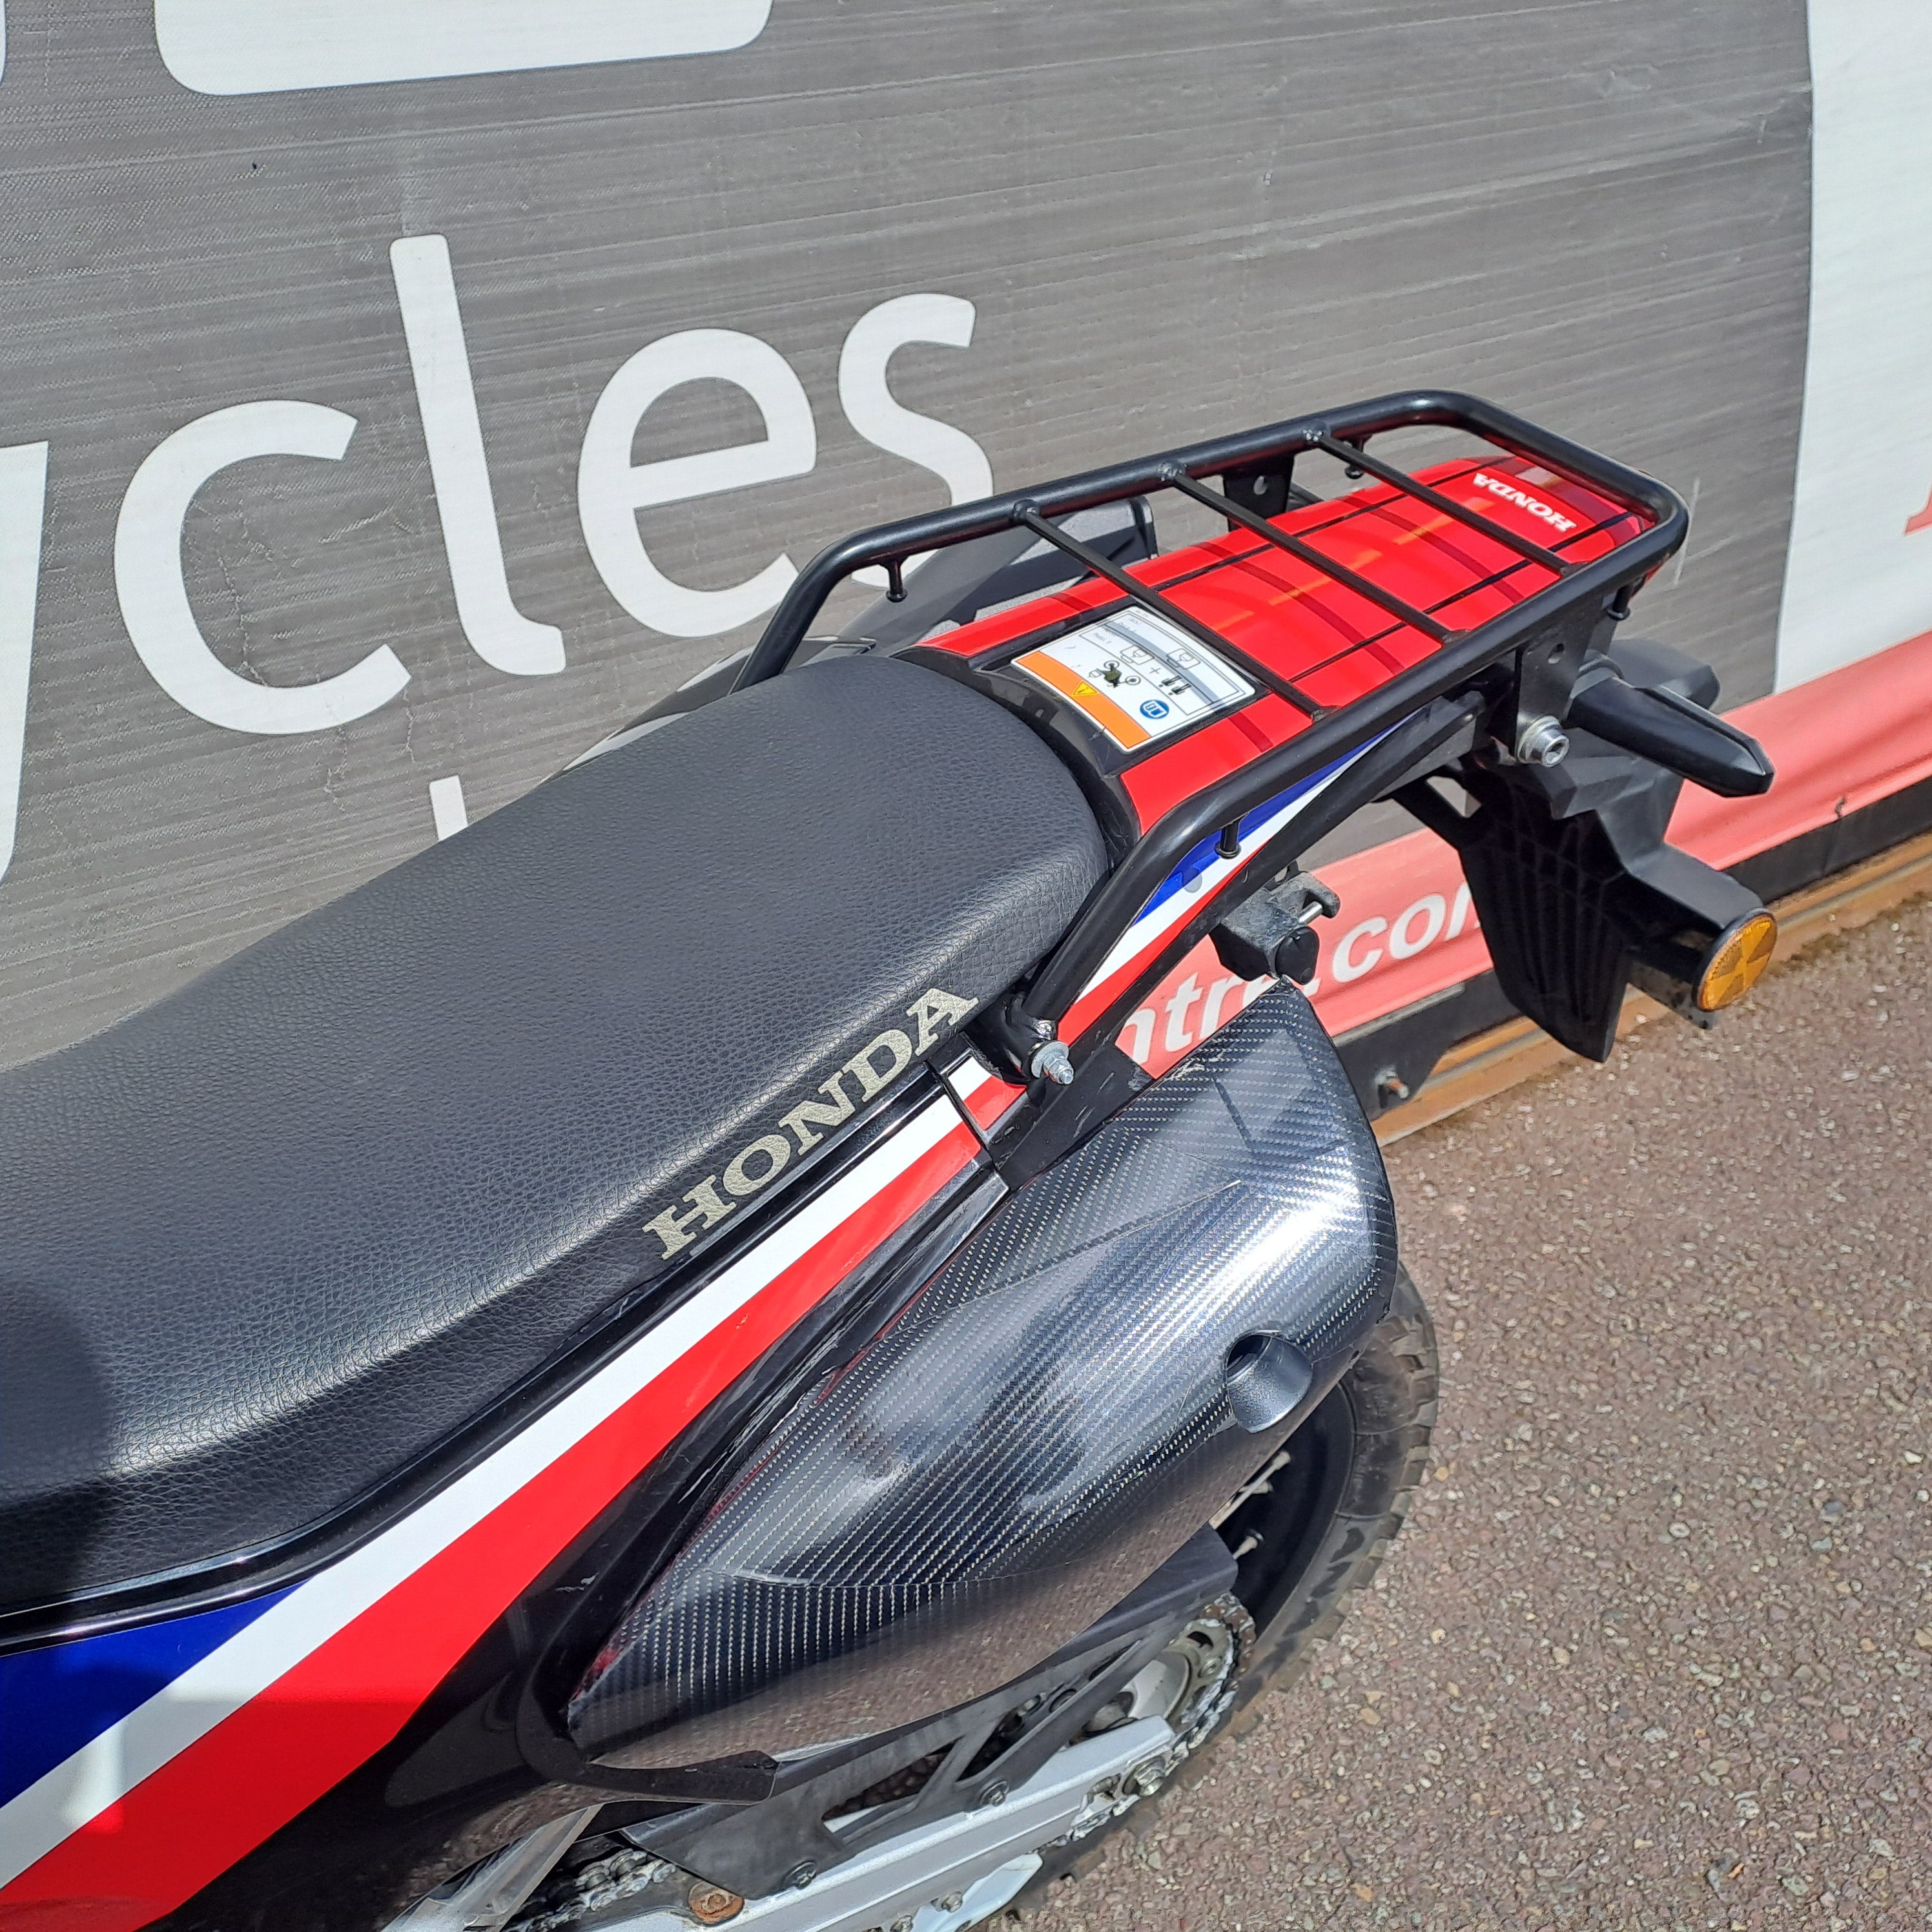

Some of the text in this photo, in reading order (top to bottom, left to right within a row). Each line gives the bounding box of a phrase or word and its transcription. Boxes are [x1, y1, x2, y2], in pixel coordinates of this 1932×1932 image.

[0, 233, 994, 882] cles
[1473, 472, 1577, 532] HONDA
[641, 987, 980, 1260] HONDA
